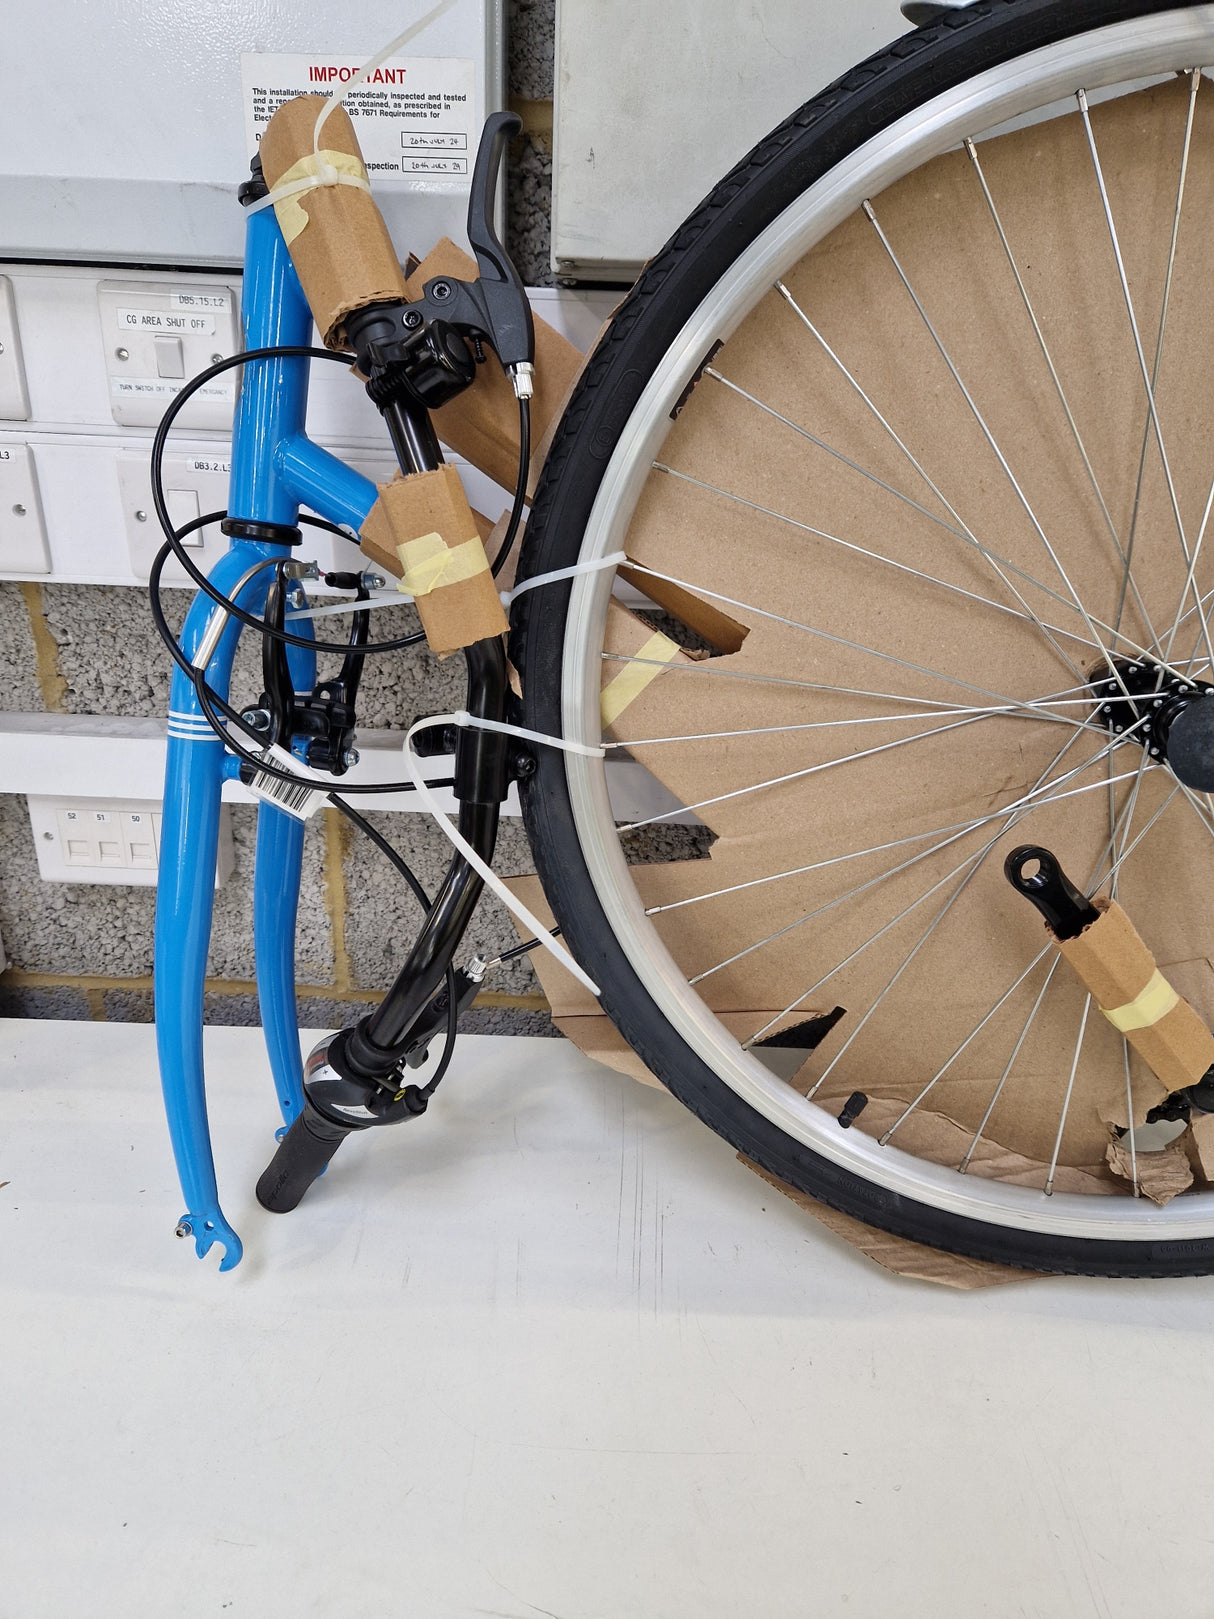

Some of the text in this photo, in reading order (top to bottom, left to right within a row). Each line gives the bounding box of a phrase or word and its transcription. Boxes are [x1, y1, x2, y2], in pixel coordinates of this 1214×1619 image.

[270, 88, 307, 96] installation
[348, 92, 388, 100] periodically
[390, 92, 426, 100] inspected
[404, 102, 442, 110] prescribed
[380, 110, 428, 118] Requirements
[126, 314, 206, 328] CG AREA SHUT OFF
